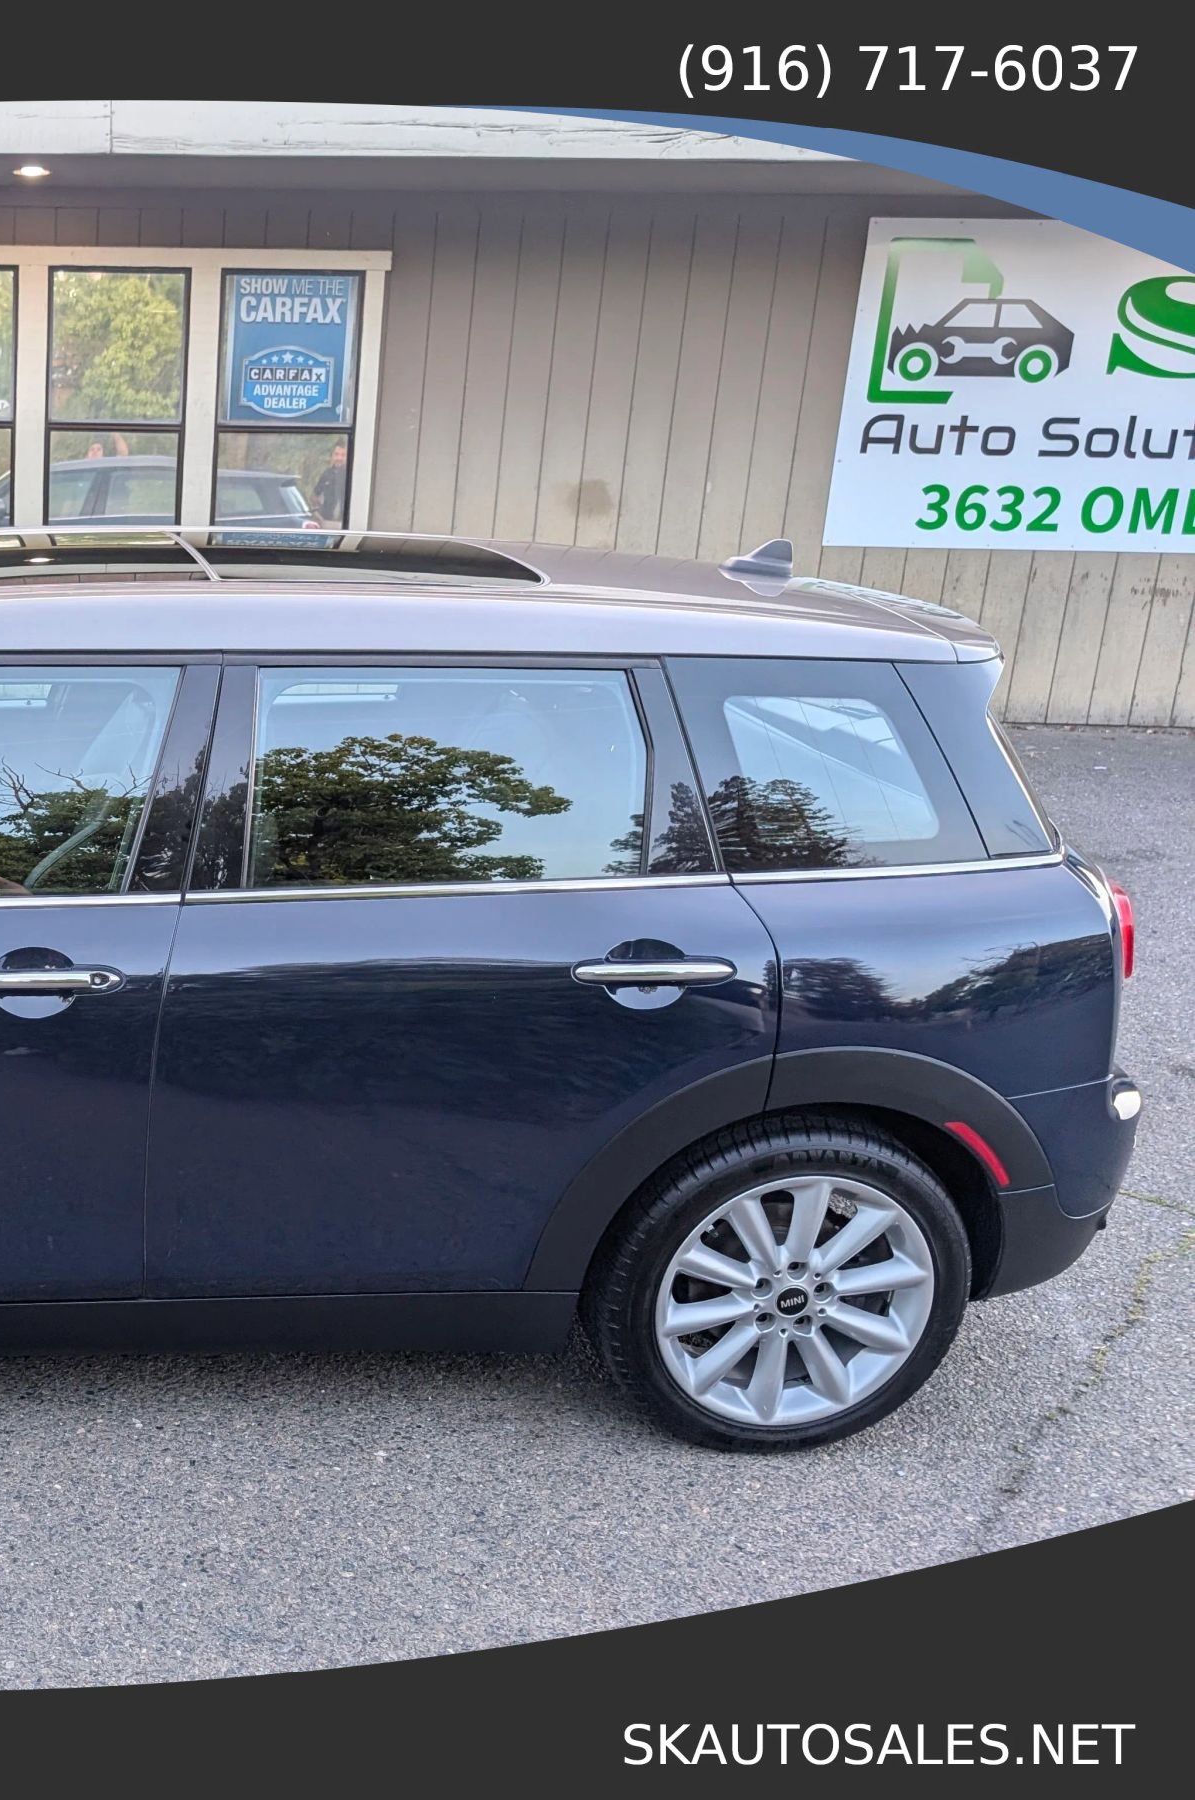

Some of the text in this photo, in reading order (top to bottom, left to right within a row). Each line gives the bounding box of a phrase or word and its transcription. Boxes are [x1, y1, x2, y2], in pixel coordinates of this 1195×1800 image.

[240, 278, 344, 296] SHOW ME THE
[240, 296, 342, 324] CARFAX
[250, 368, 324, 382] CARFAX
[253, 384, 319, 396] ADVANTAGE
[264, 397, 307, 409] DEALER
[859, 414, 1016, 456] Auto
[915, 484, 1061, 532] 3632
[780, 1294, 805, 1309] MINI
